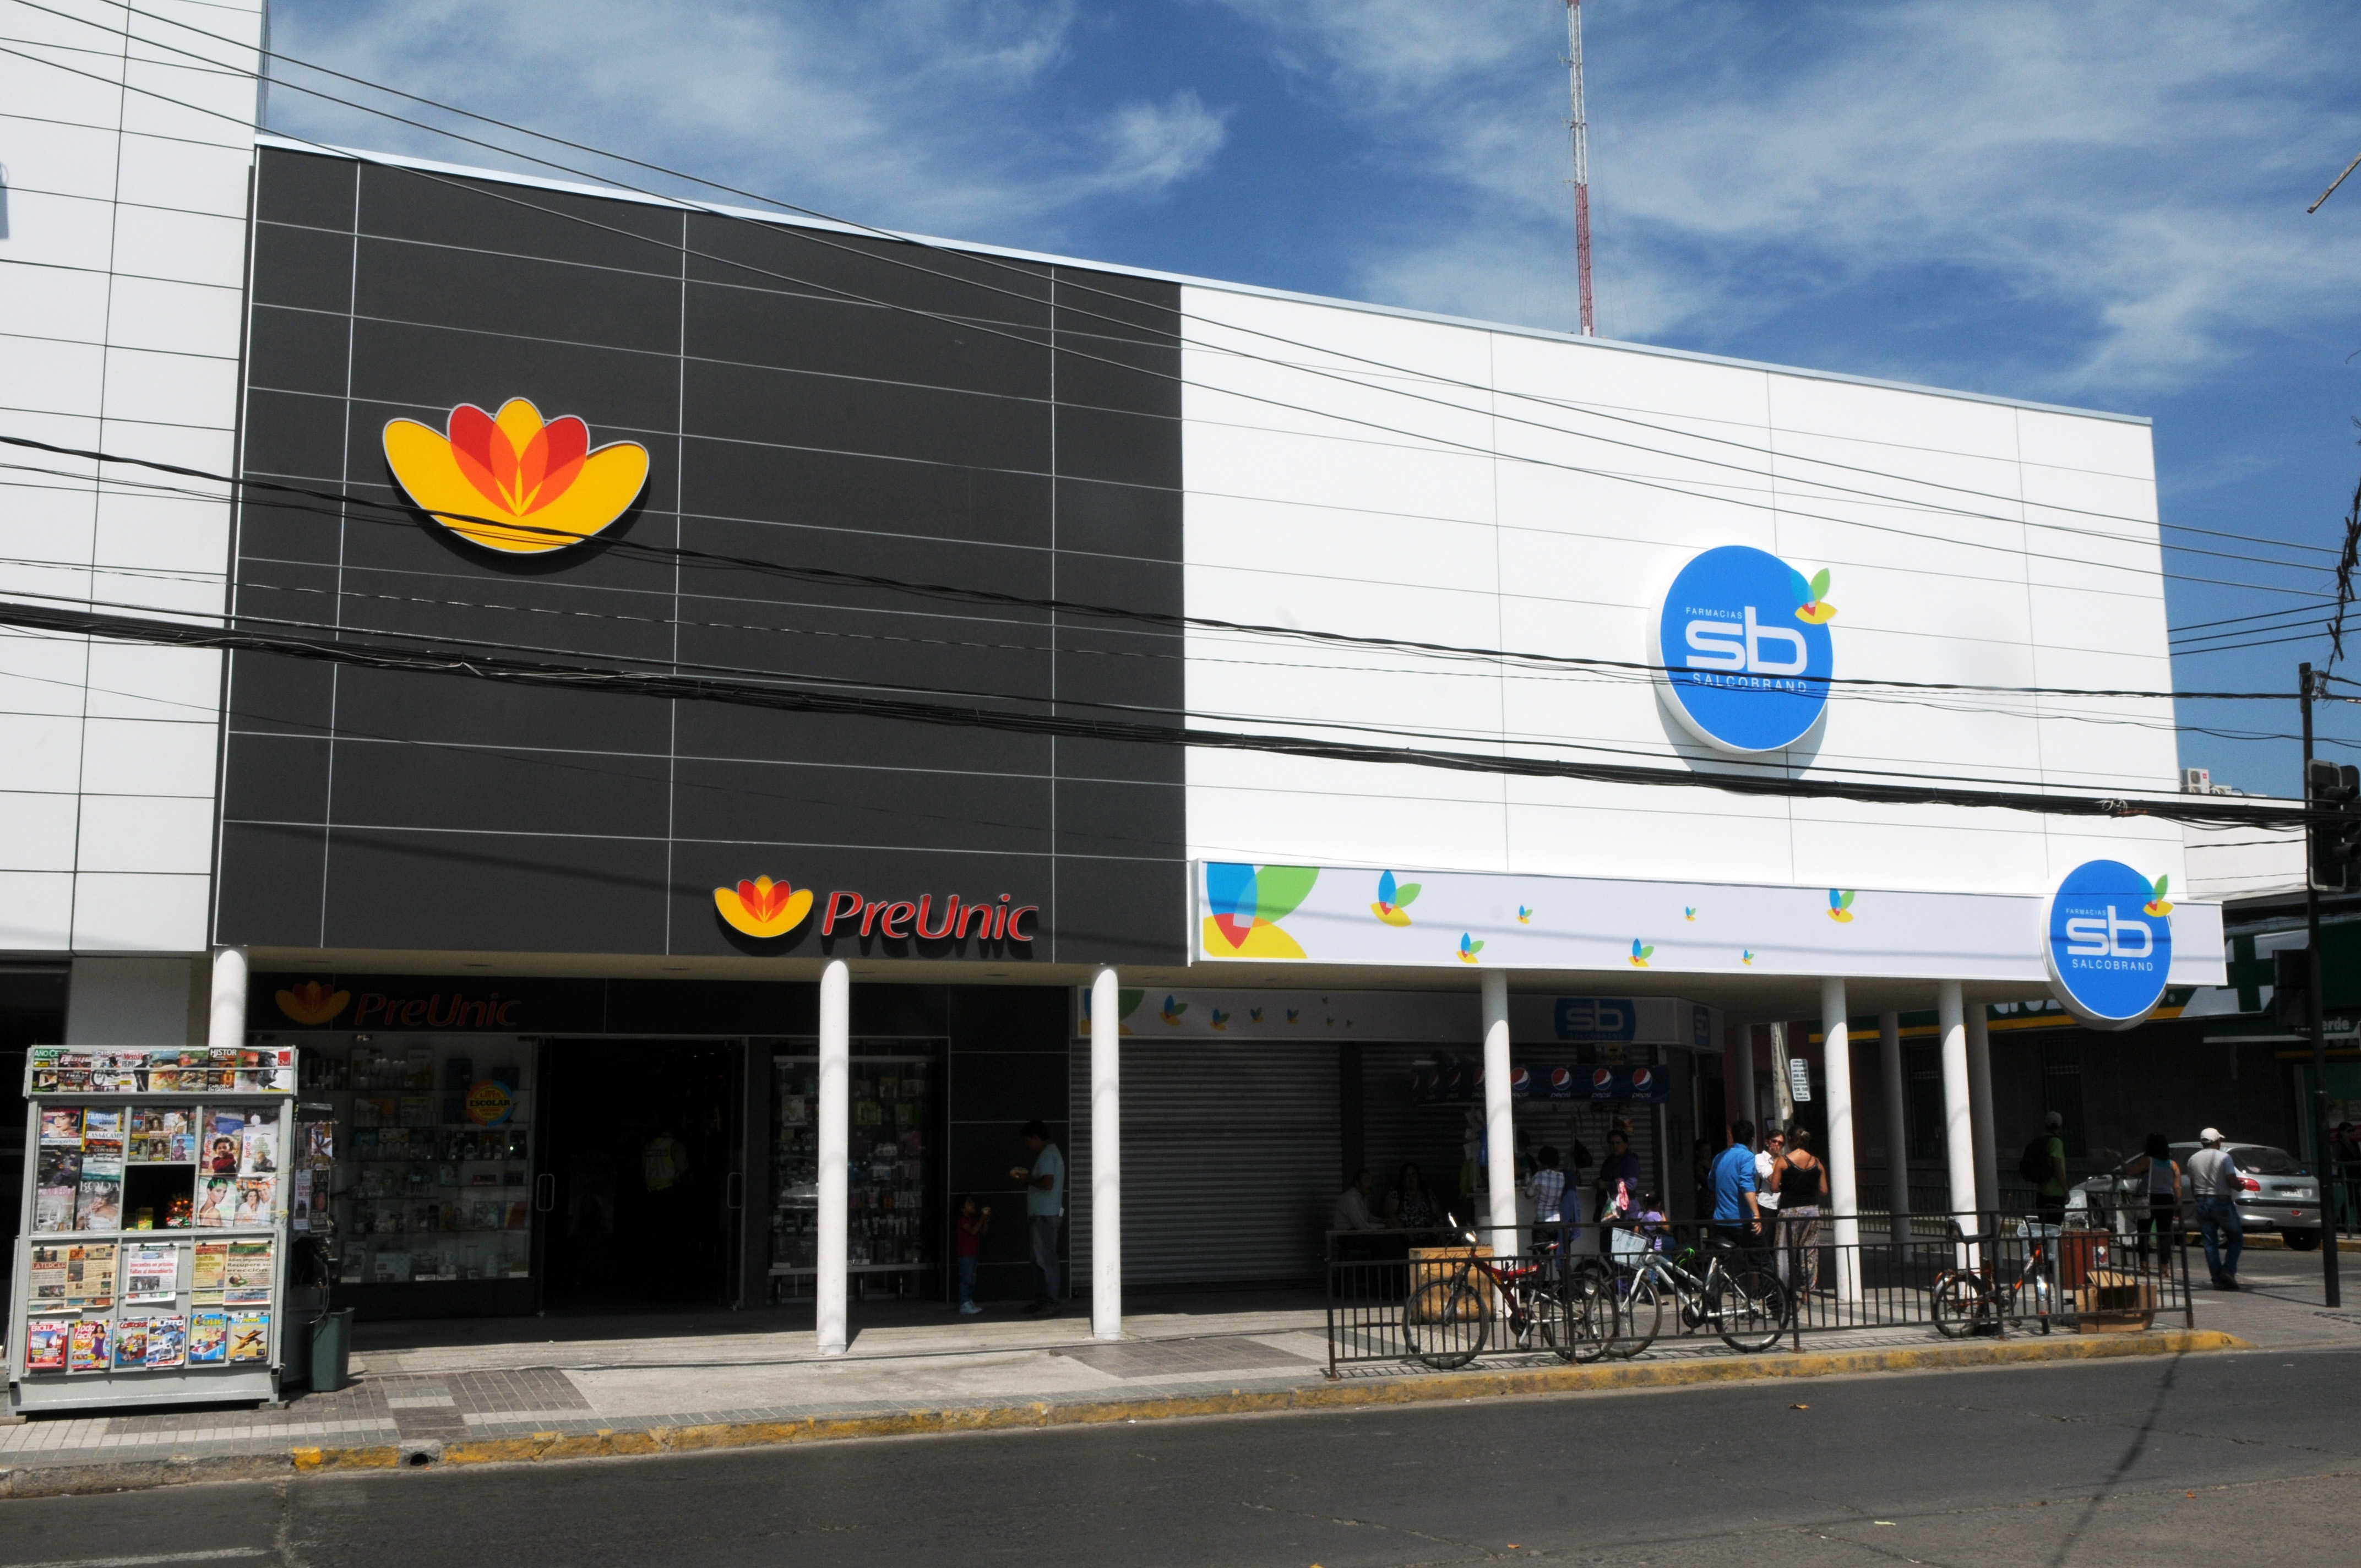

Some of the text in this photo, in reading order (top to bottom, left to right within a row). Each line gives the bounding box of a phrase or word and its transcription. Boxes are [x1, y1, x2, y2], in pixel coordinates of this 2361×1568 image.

[1685, 607, 1743, 619] FARMACIAS
[1685, 606, 1808, 676] sb
[1693, 673, 1807, 692] SALCOBRAND
[822, 891, 1039, 941] PreUnic
[2066, 908, 2107, 916] FARMACIAS
[2066, 905, 2153, 958] sb
[2072, 959, 2153, 971] SALCOBRAND
[354, 992, 522, 1027] PreUnic
[1566, 999, 1624, 1032] sb
[2321, 1016, 2350, 1031] erde
